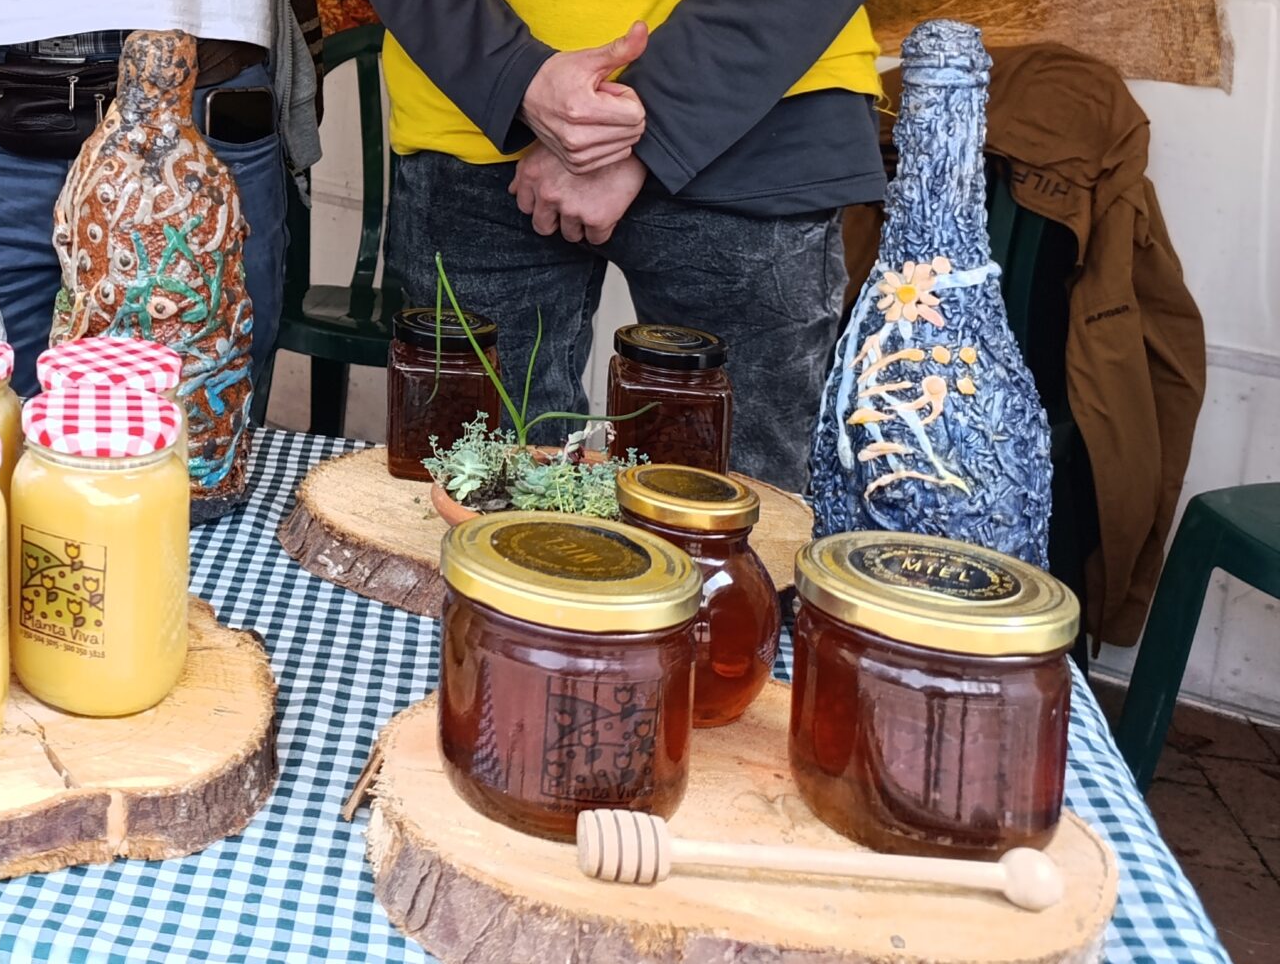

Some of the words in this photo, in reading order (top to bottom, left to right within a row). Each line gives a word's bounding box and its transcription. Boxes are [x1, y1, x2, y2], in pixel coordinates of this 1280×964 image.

[902, 556, 971, 583] MIEL
[23, 612, 67, 637] Planta
[70, 627, 99, 645] Viva
[548, 779, 610, 798] Planta
